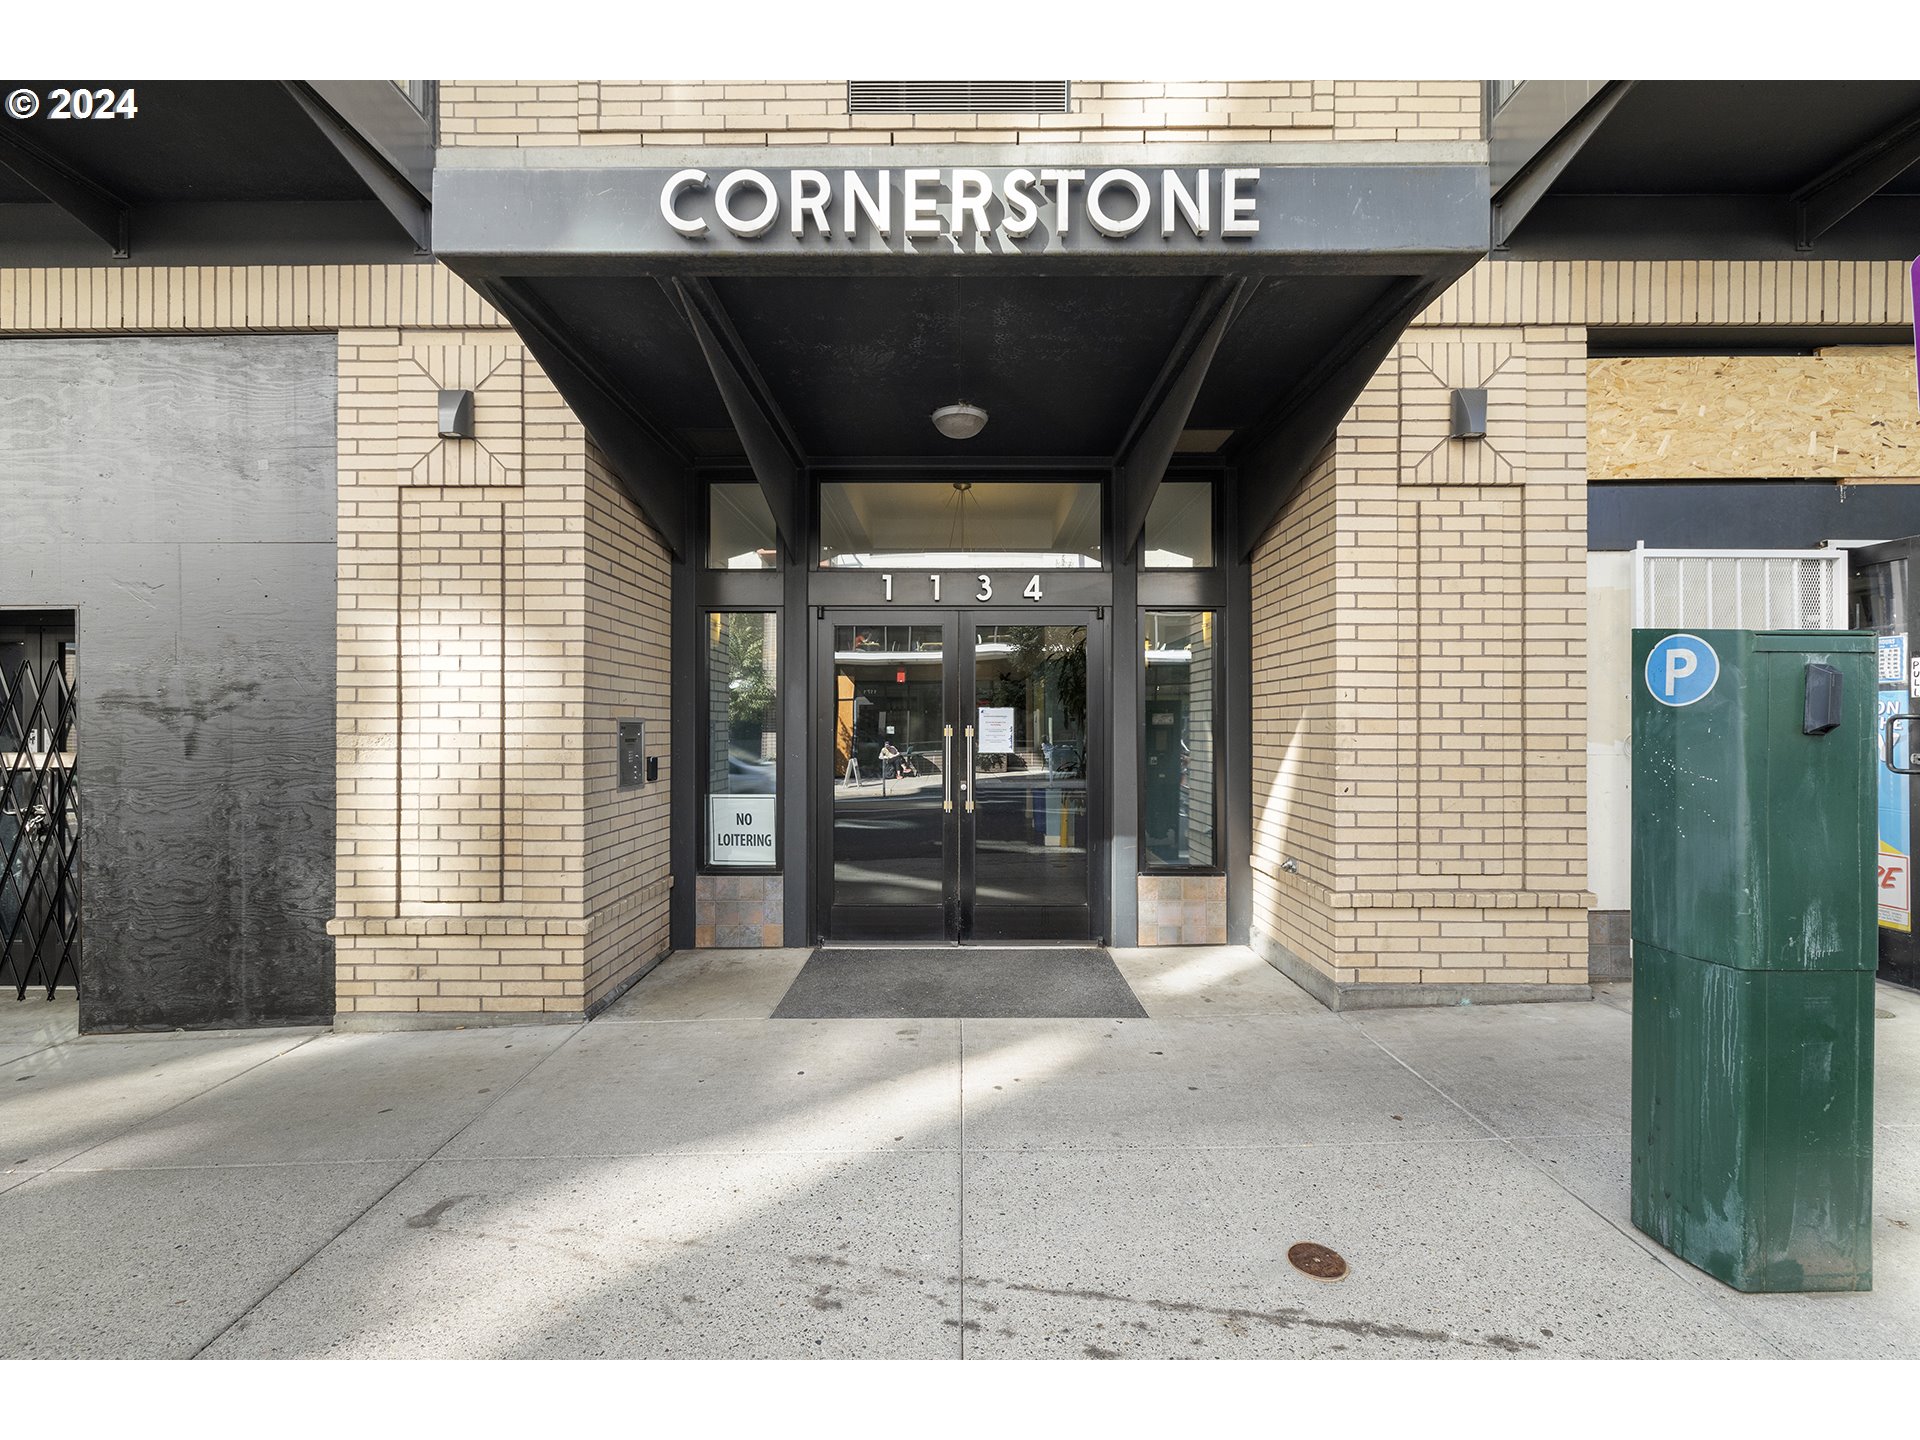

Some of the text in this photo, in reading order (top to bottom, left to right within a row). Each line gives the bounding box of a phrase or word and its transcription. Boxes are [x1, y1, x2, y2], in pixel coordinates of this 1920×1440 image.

[660, 168, 1261, 239] CORNERSTONE
[1665, 648, 1698, 697] P
[1912, 661, 1920, 697] PULL
[736, 813, 752, 826] NO
[718, 833, 772, 847] LOITERING
